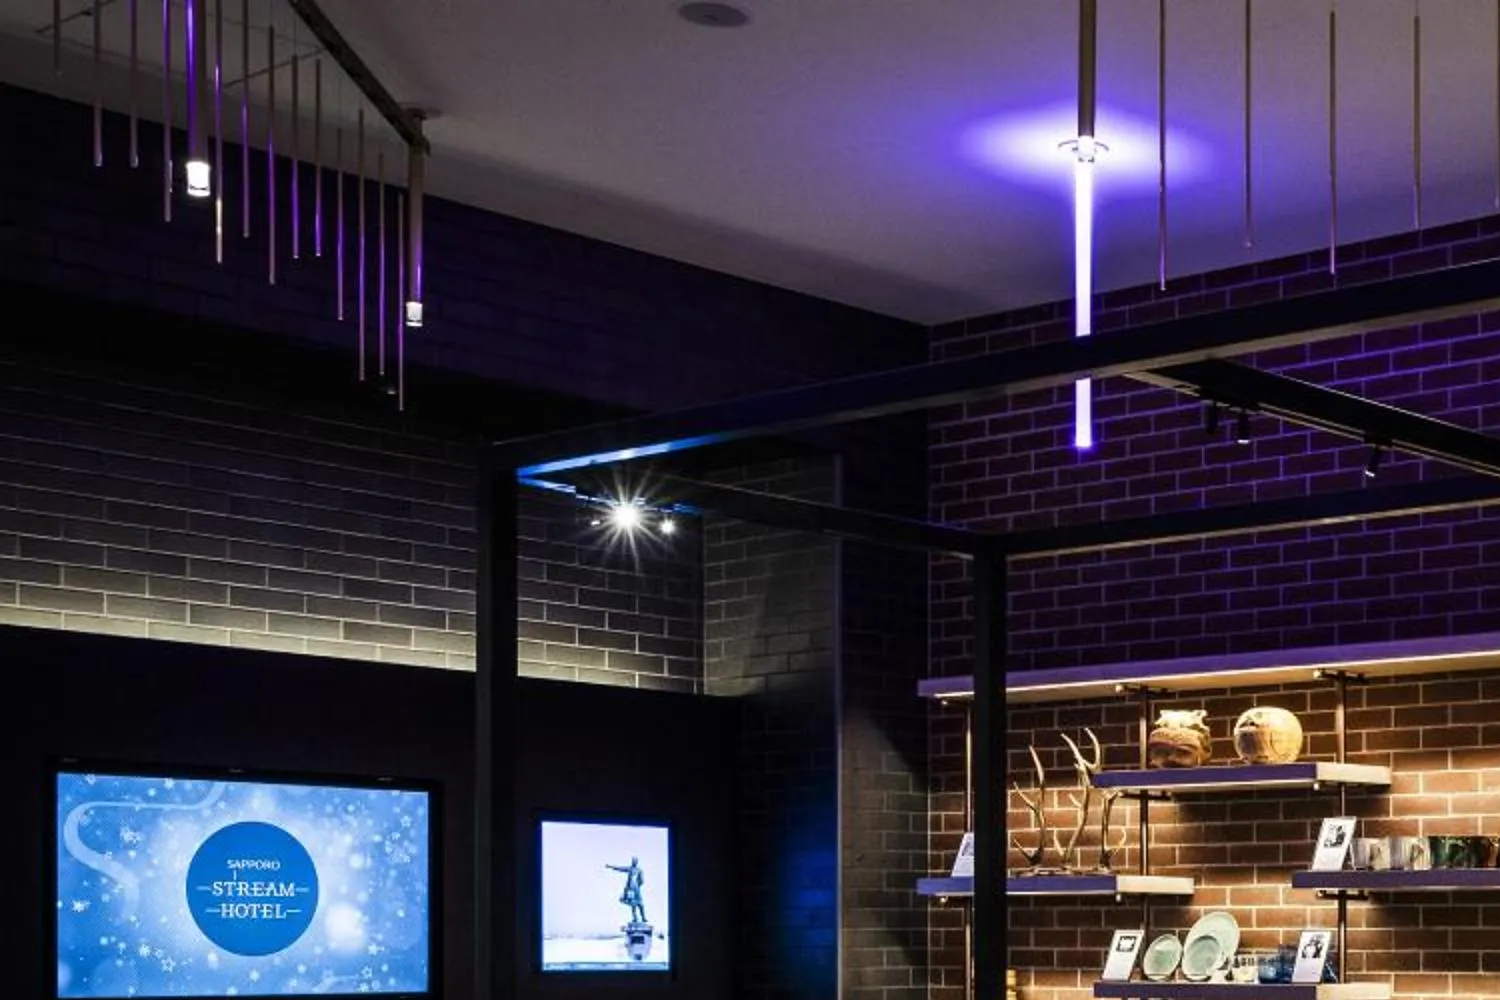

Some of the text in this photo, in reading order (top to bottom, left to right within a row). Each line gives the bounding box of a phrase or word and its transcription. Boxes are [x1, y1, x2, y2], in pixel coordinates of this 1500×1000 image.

[227, 859, 281, 870] SAPPORO
[211, 881, 295, 897] STREAM
[221, 903, 287, 919] HOTEL
